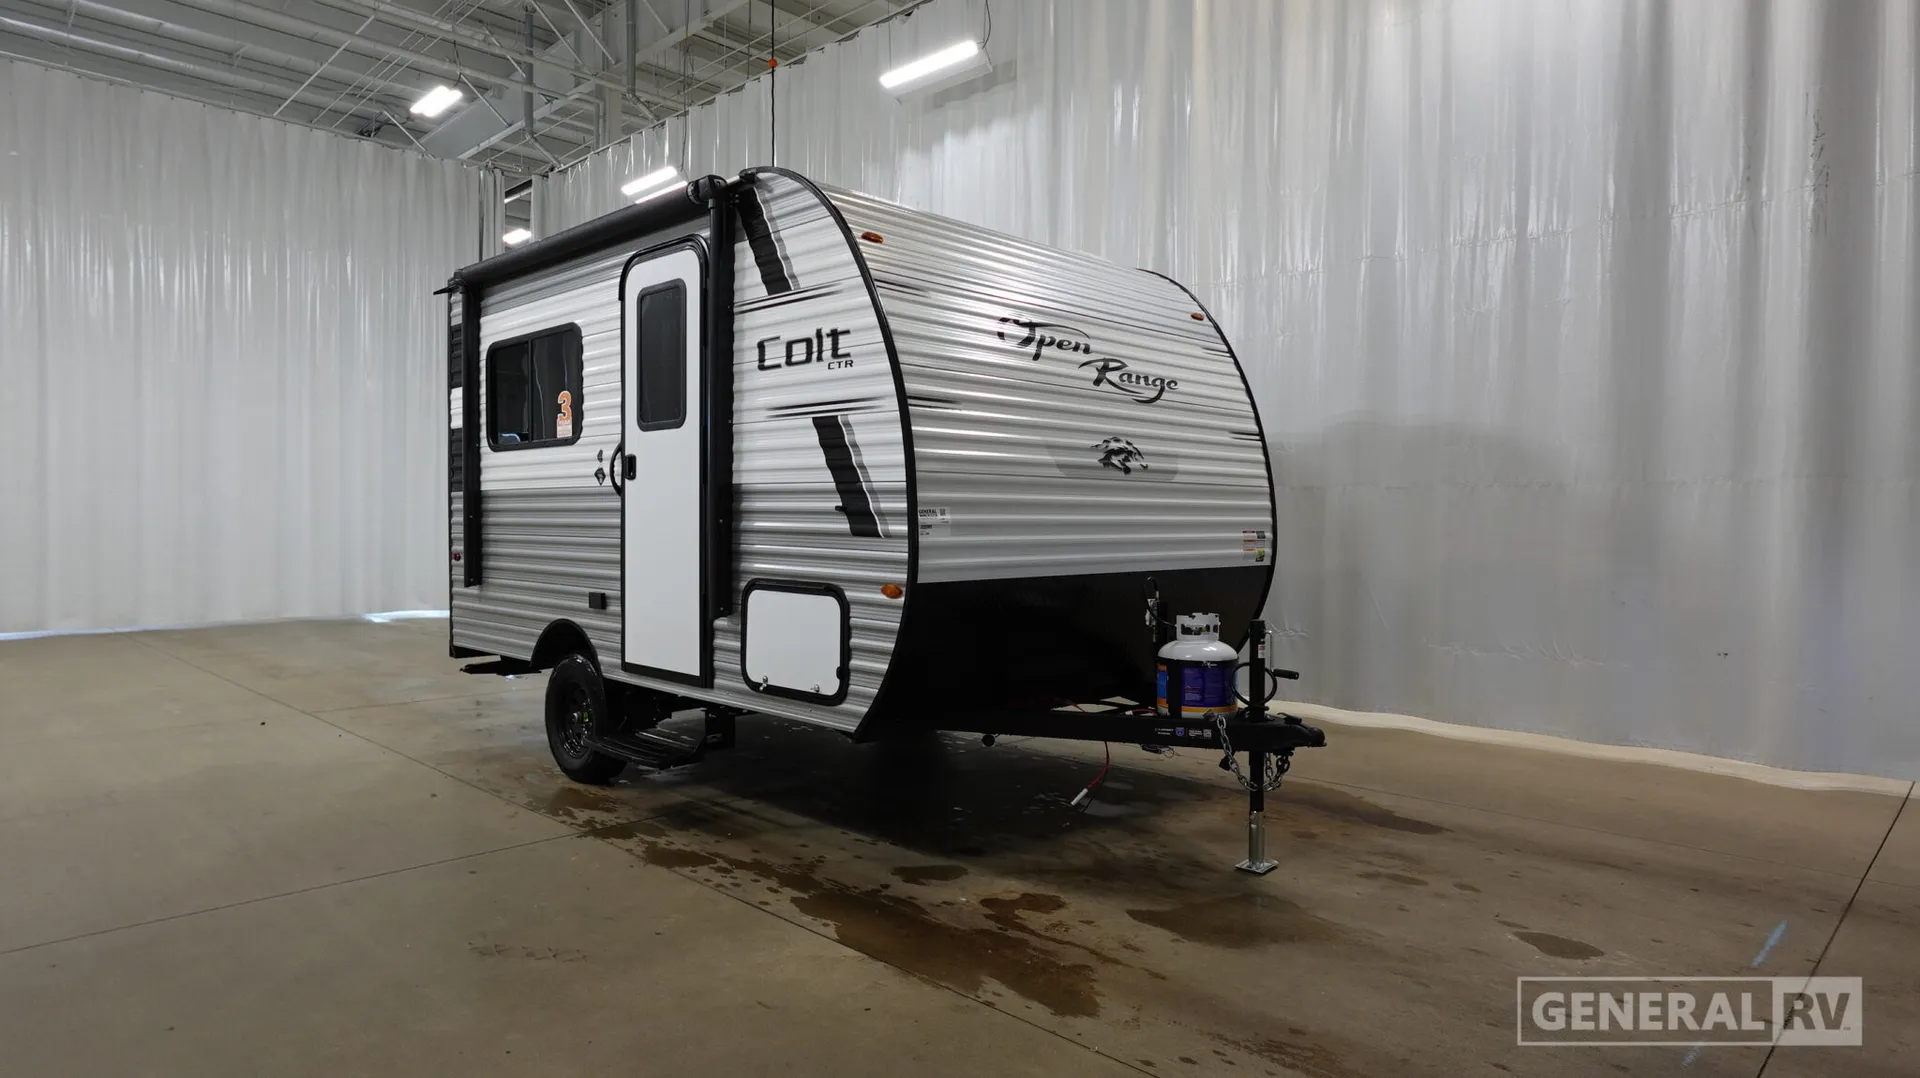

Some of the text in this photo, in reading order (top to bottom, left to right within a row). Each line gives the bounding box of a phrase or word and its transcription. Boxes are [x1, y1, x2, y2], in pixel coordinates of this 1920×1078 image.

[757, 327, 851, 371] Colt
[827, 359, 854, 370] CTR
[1078, 358, 1179, 404] Range
[558, 390, 572, 420] 3
